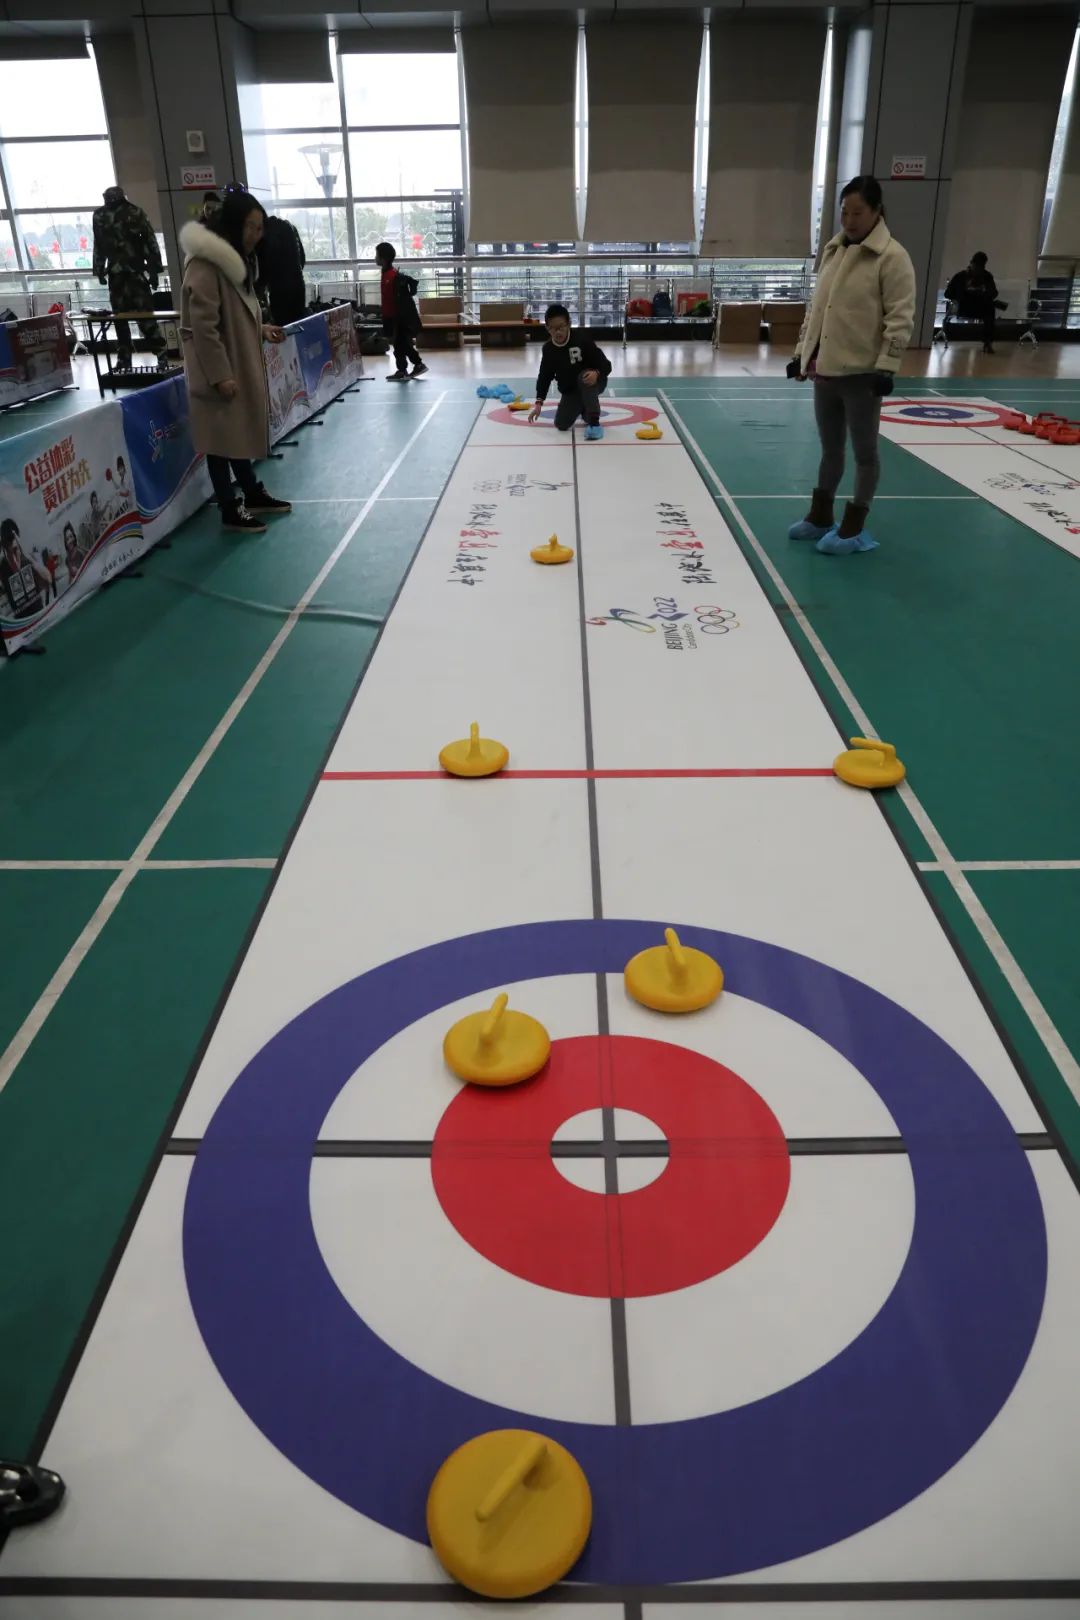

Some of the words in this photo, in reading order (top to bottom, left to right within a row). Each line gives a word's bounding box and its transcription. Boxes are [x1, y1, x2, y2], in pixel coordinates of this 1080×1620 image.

[569, 347, 582, 364] R
[645, 596, 690, 622] 2022
[661, 623, 684, 650] BEIJING
